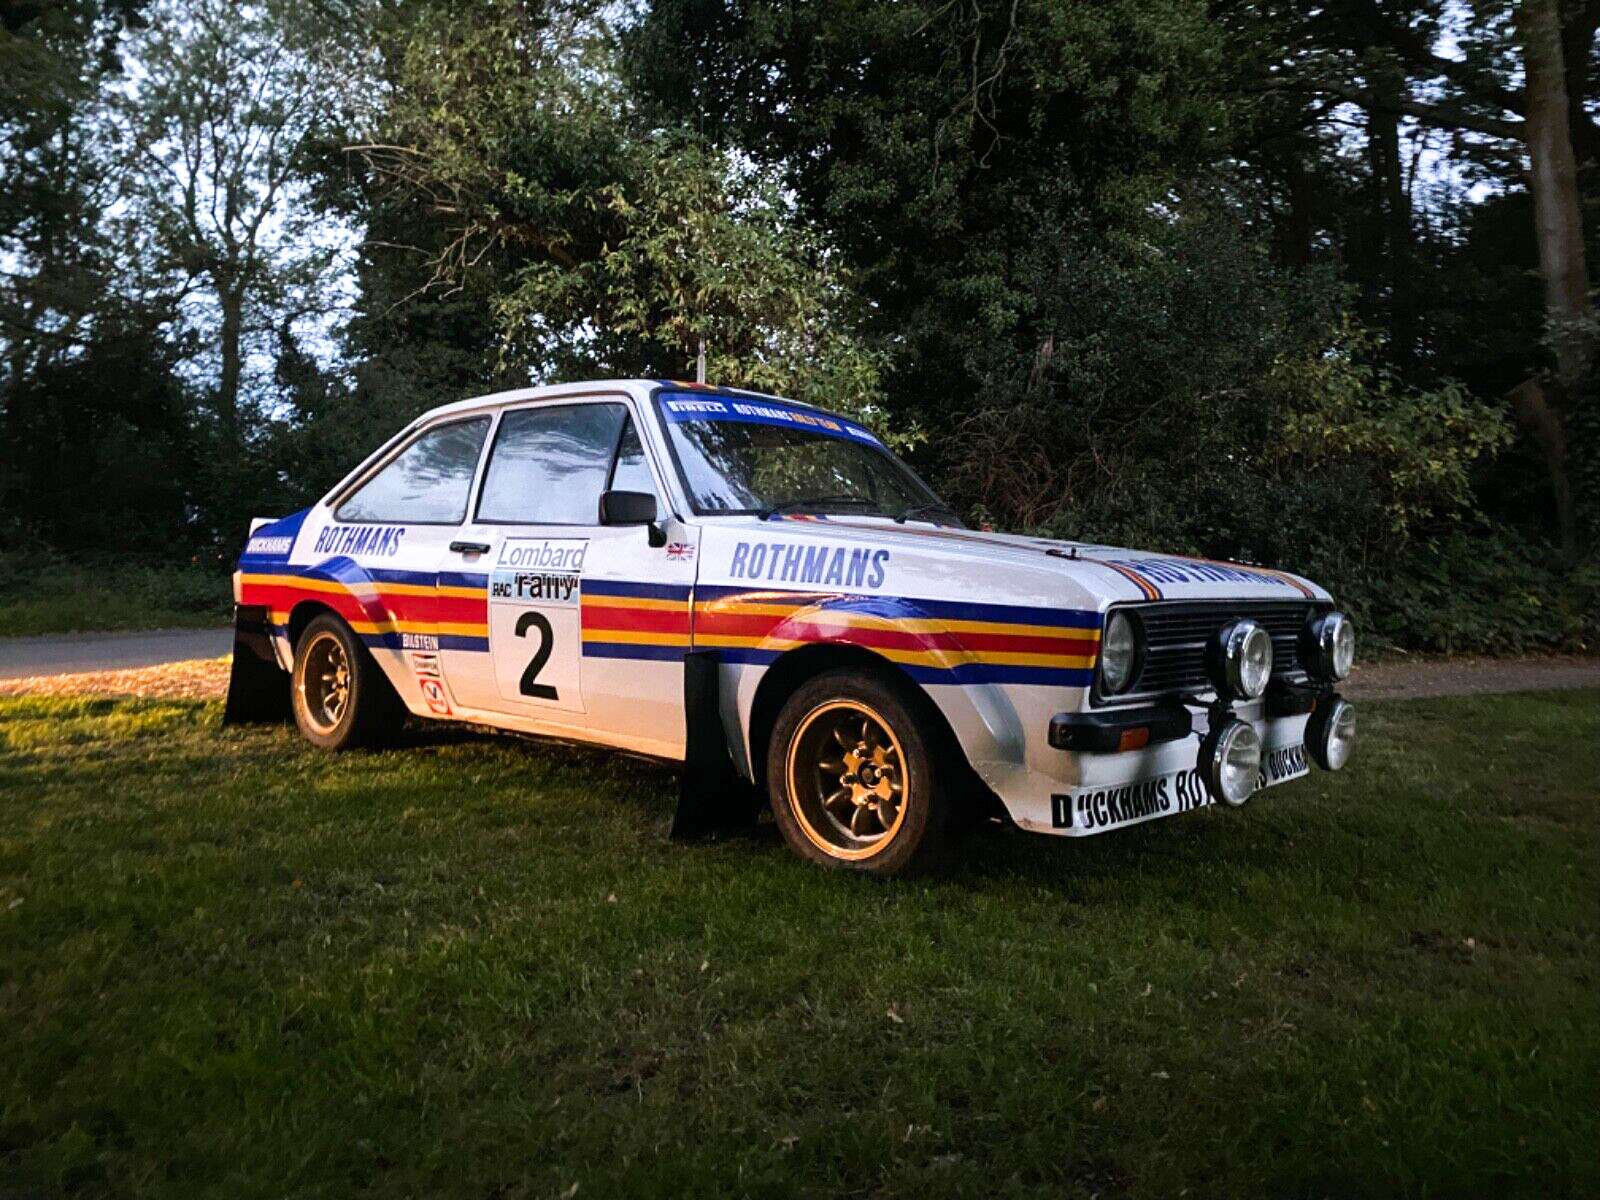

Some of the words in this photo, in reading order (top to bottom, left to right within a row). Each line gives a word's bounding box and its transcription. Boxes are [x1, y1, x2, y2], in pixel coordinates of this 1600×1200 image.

[732, 403, 792, 421] ROTHMANS
[314, 526, 405, 556] ROTHMANS
[496, 541, 588, 568] Lombard
[730, 542, 889, 588] ROTHMANS
[492, 582, 512, 598] RAC
[517, 574, 575, 600] rally
[515, 611, 559, 701] 2
[1051, 777, 1171, 829] DUCKHAMS
